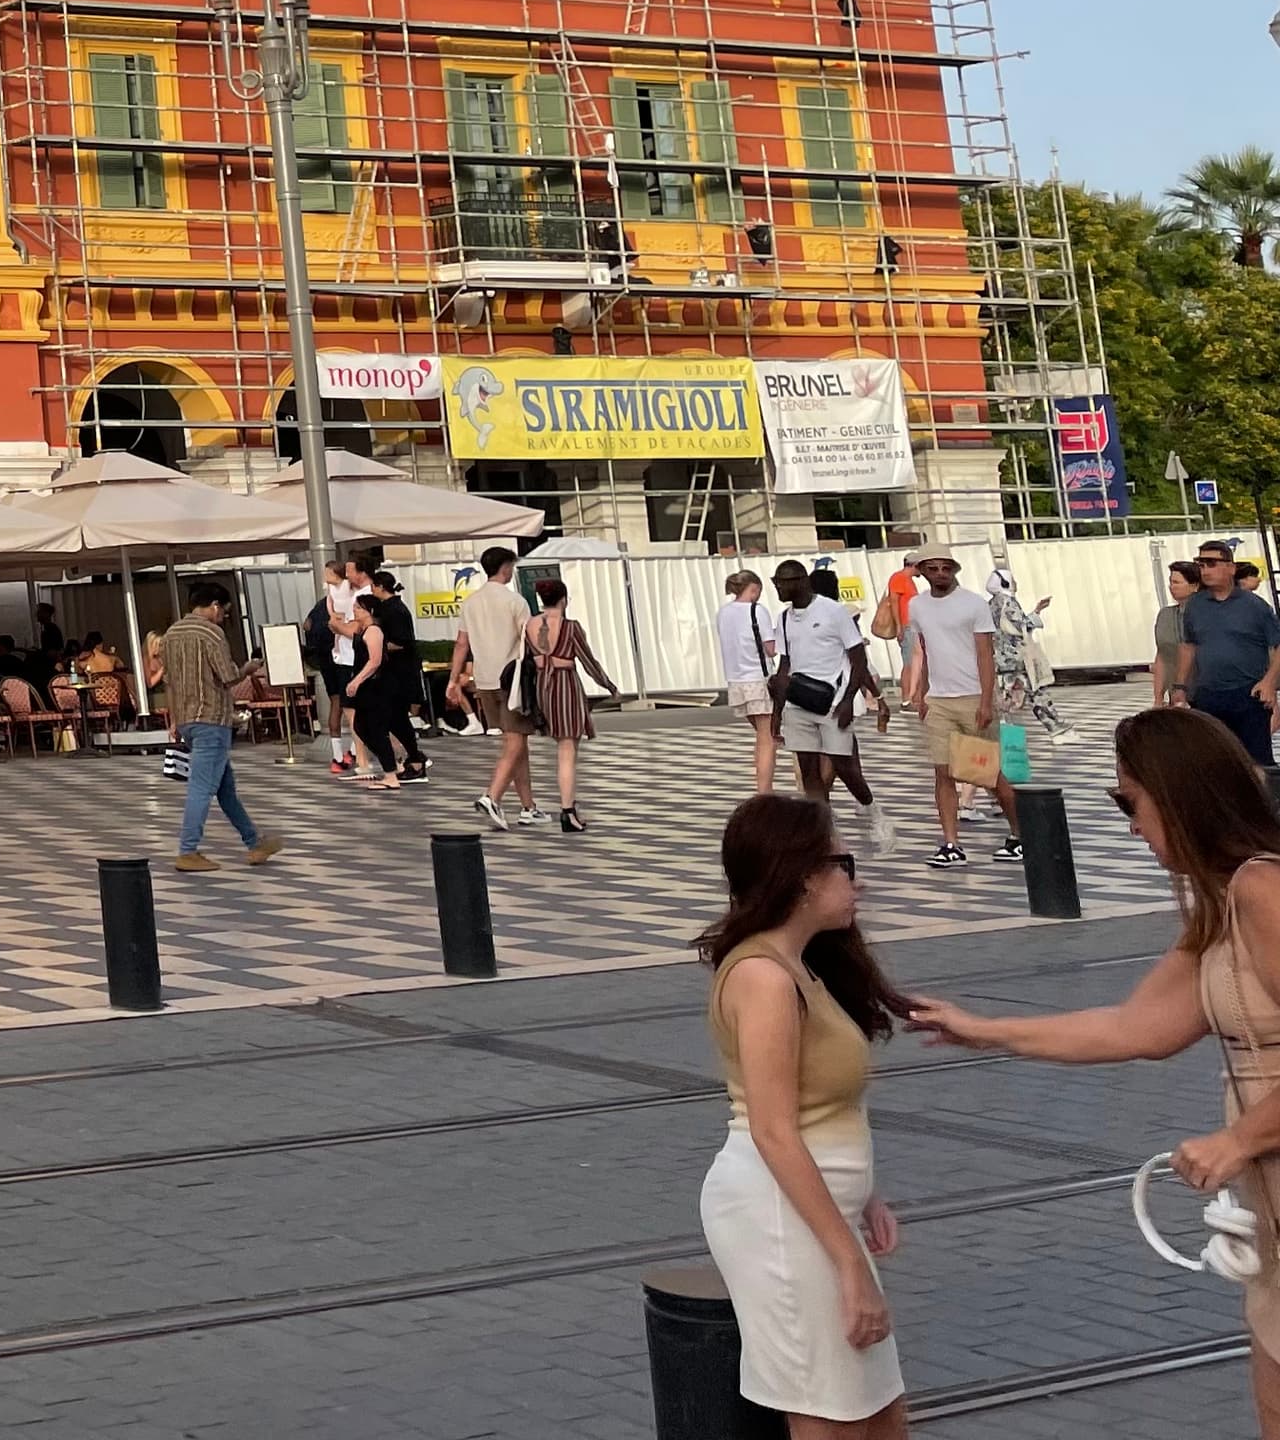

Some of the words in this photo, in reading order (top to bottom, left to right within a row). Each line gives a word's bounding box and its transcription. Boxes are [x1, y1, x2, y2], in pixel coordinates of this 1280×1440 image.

[764, 373, 852, 398] BRUNEL
[514, 378, 750, 433] STRAMIGIOLI
[839, 424, 873, 438] GENIE
[875, 423, 901, 435] CIVIL
[527, 436, 639, 450] RAVALEMENT
[648, 436, 670, 450] DE
[677, 435, 753, 451] FAÇADES
